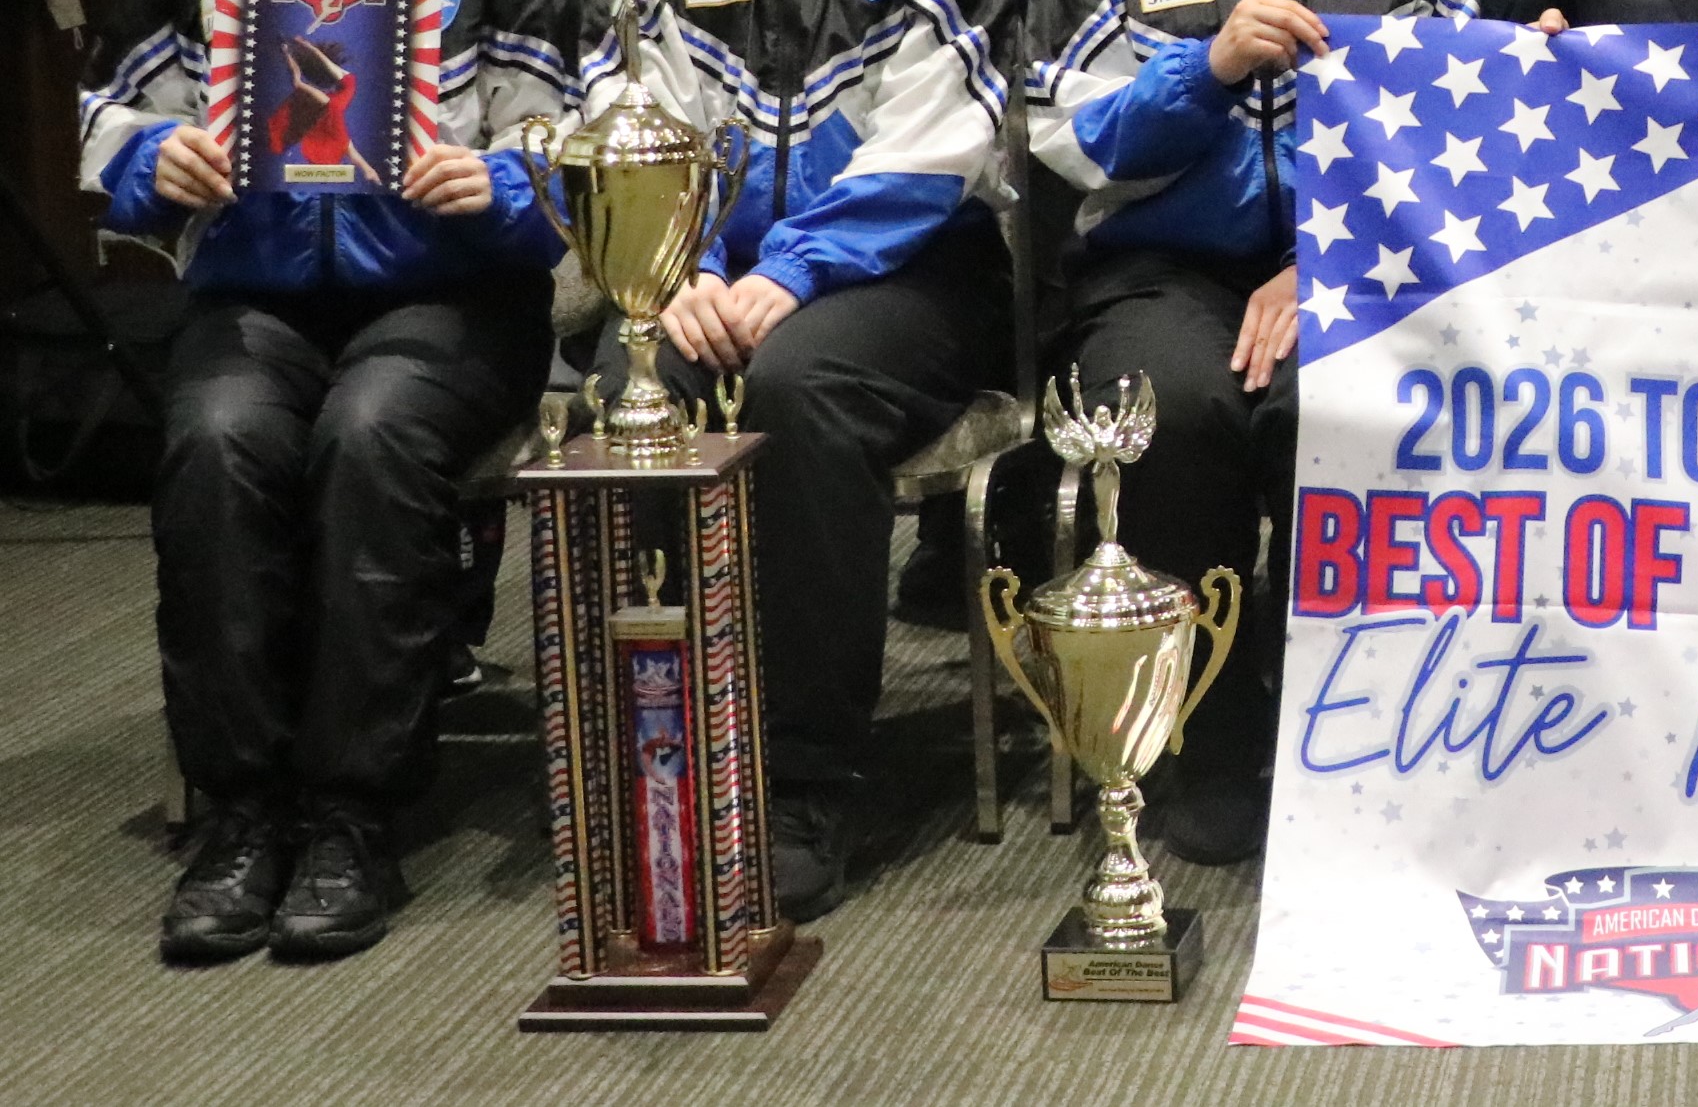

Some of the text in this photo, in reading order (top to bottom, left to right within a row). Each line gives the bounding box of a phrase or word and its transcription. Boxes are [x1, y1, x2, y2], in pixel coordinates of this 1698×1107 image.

[1395, 367, 1606, 473] 2026
[1291, 488, 1548, 623] BEST
[1562, 494, 1690, 629] OF
[1300, 607, 1608, 782] Elite
[1592, 907, 1685, 936] AMERICAN
